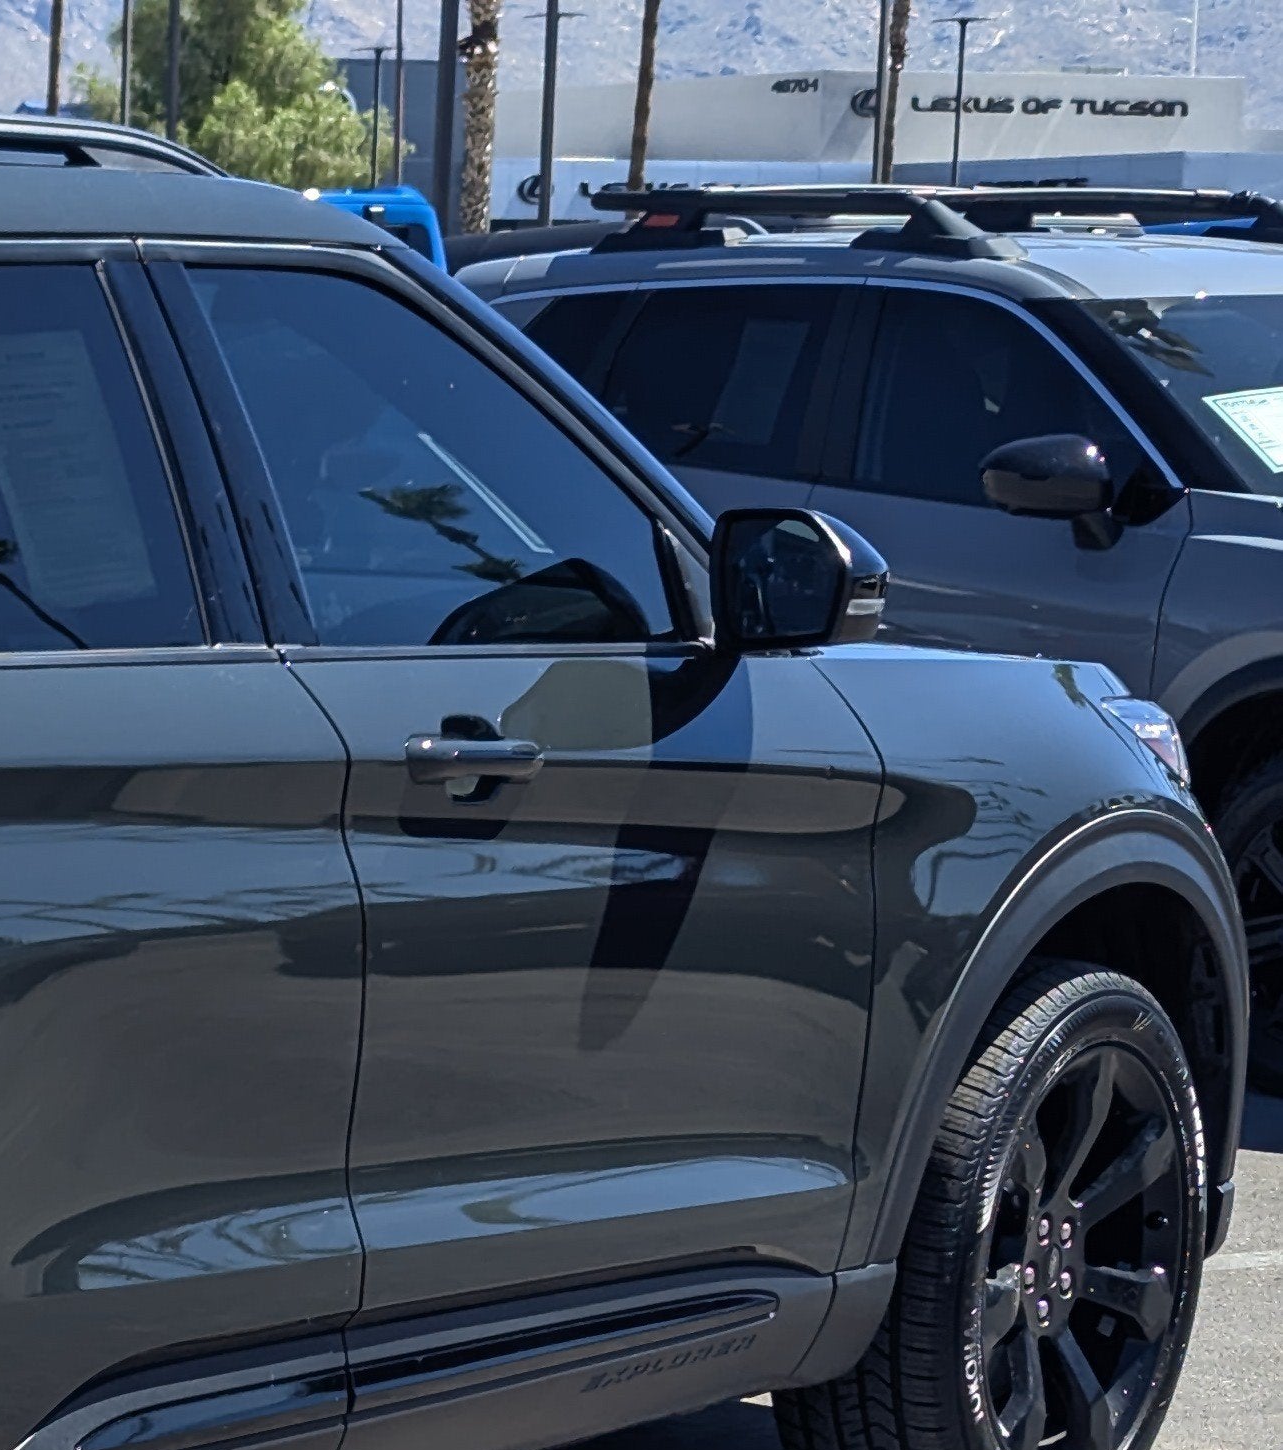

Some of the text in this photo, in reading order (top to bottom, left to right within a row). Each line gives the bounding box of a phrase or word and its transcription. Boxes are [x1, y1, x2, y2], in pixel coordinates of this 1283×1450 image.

[911, 96, 1189, 117] LEXUS OF TUCSON
[581, 1334, 757, 1393] EXPLORER
